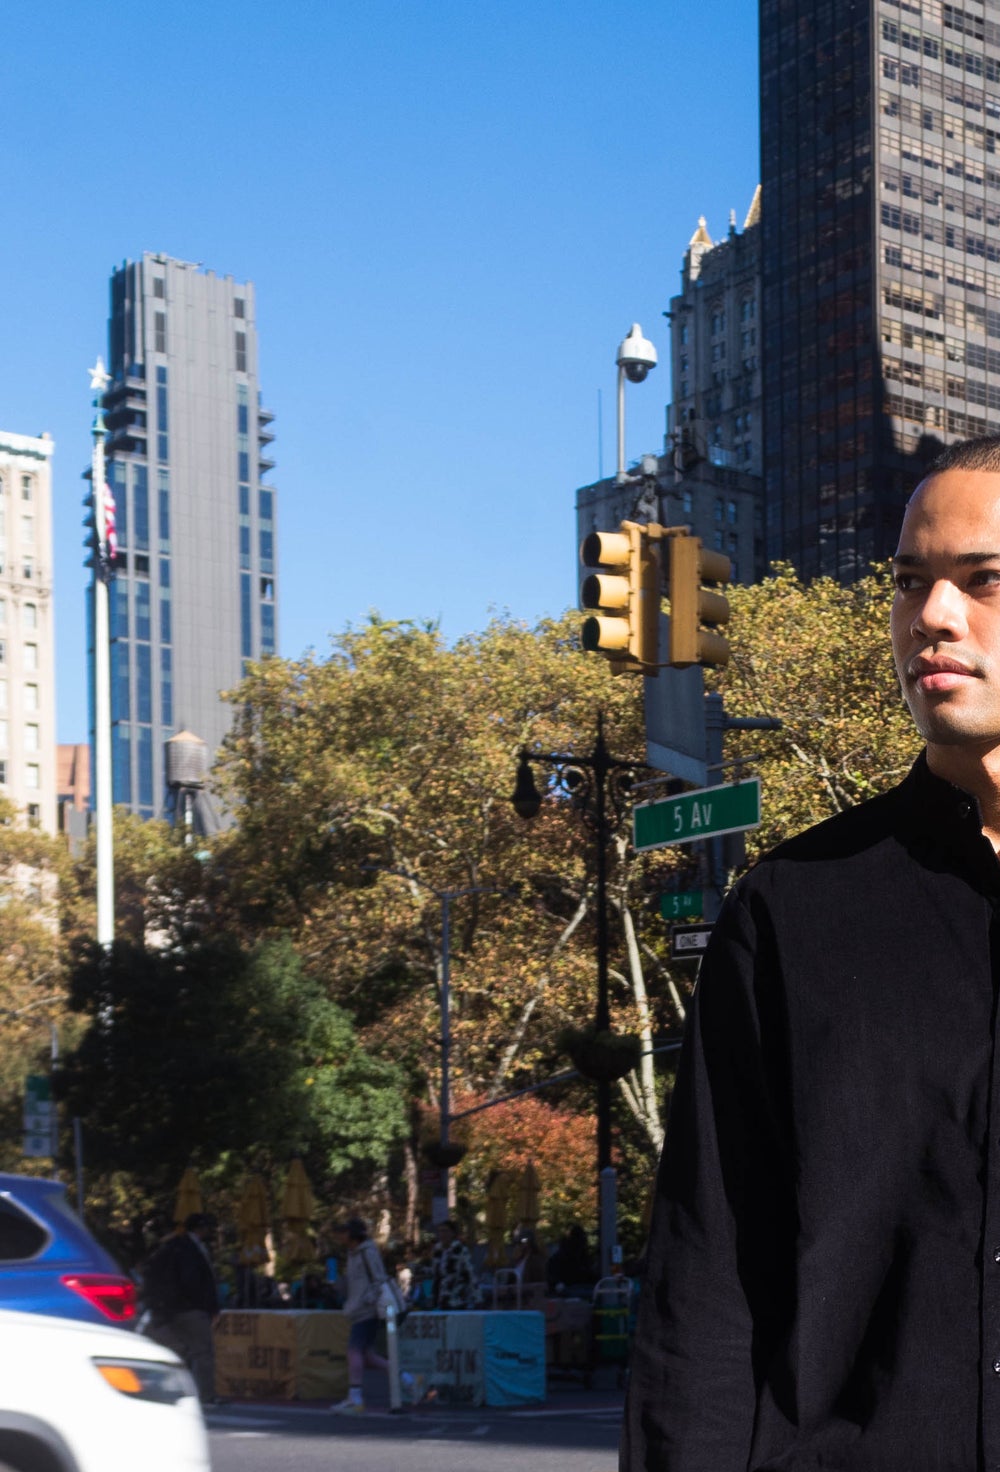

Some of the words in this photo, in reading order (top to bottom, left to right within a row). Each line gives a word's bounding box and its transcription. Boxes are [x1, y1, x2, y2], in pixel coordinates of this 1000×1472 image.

[674, 805, 683, 833] 5
[672, 896, 679, 914] 5
[680, 934, 697, 947] ONE
